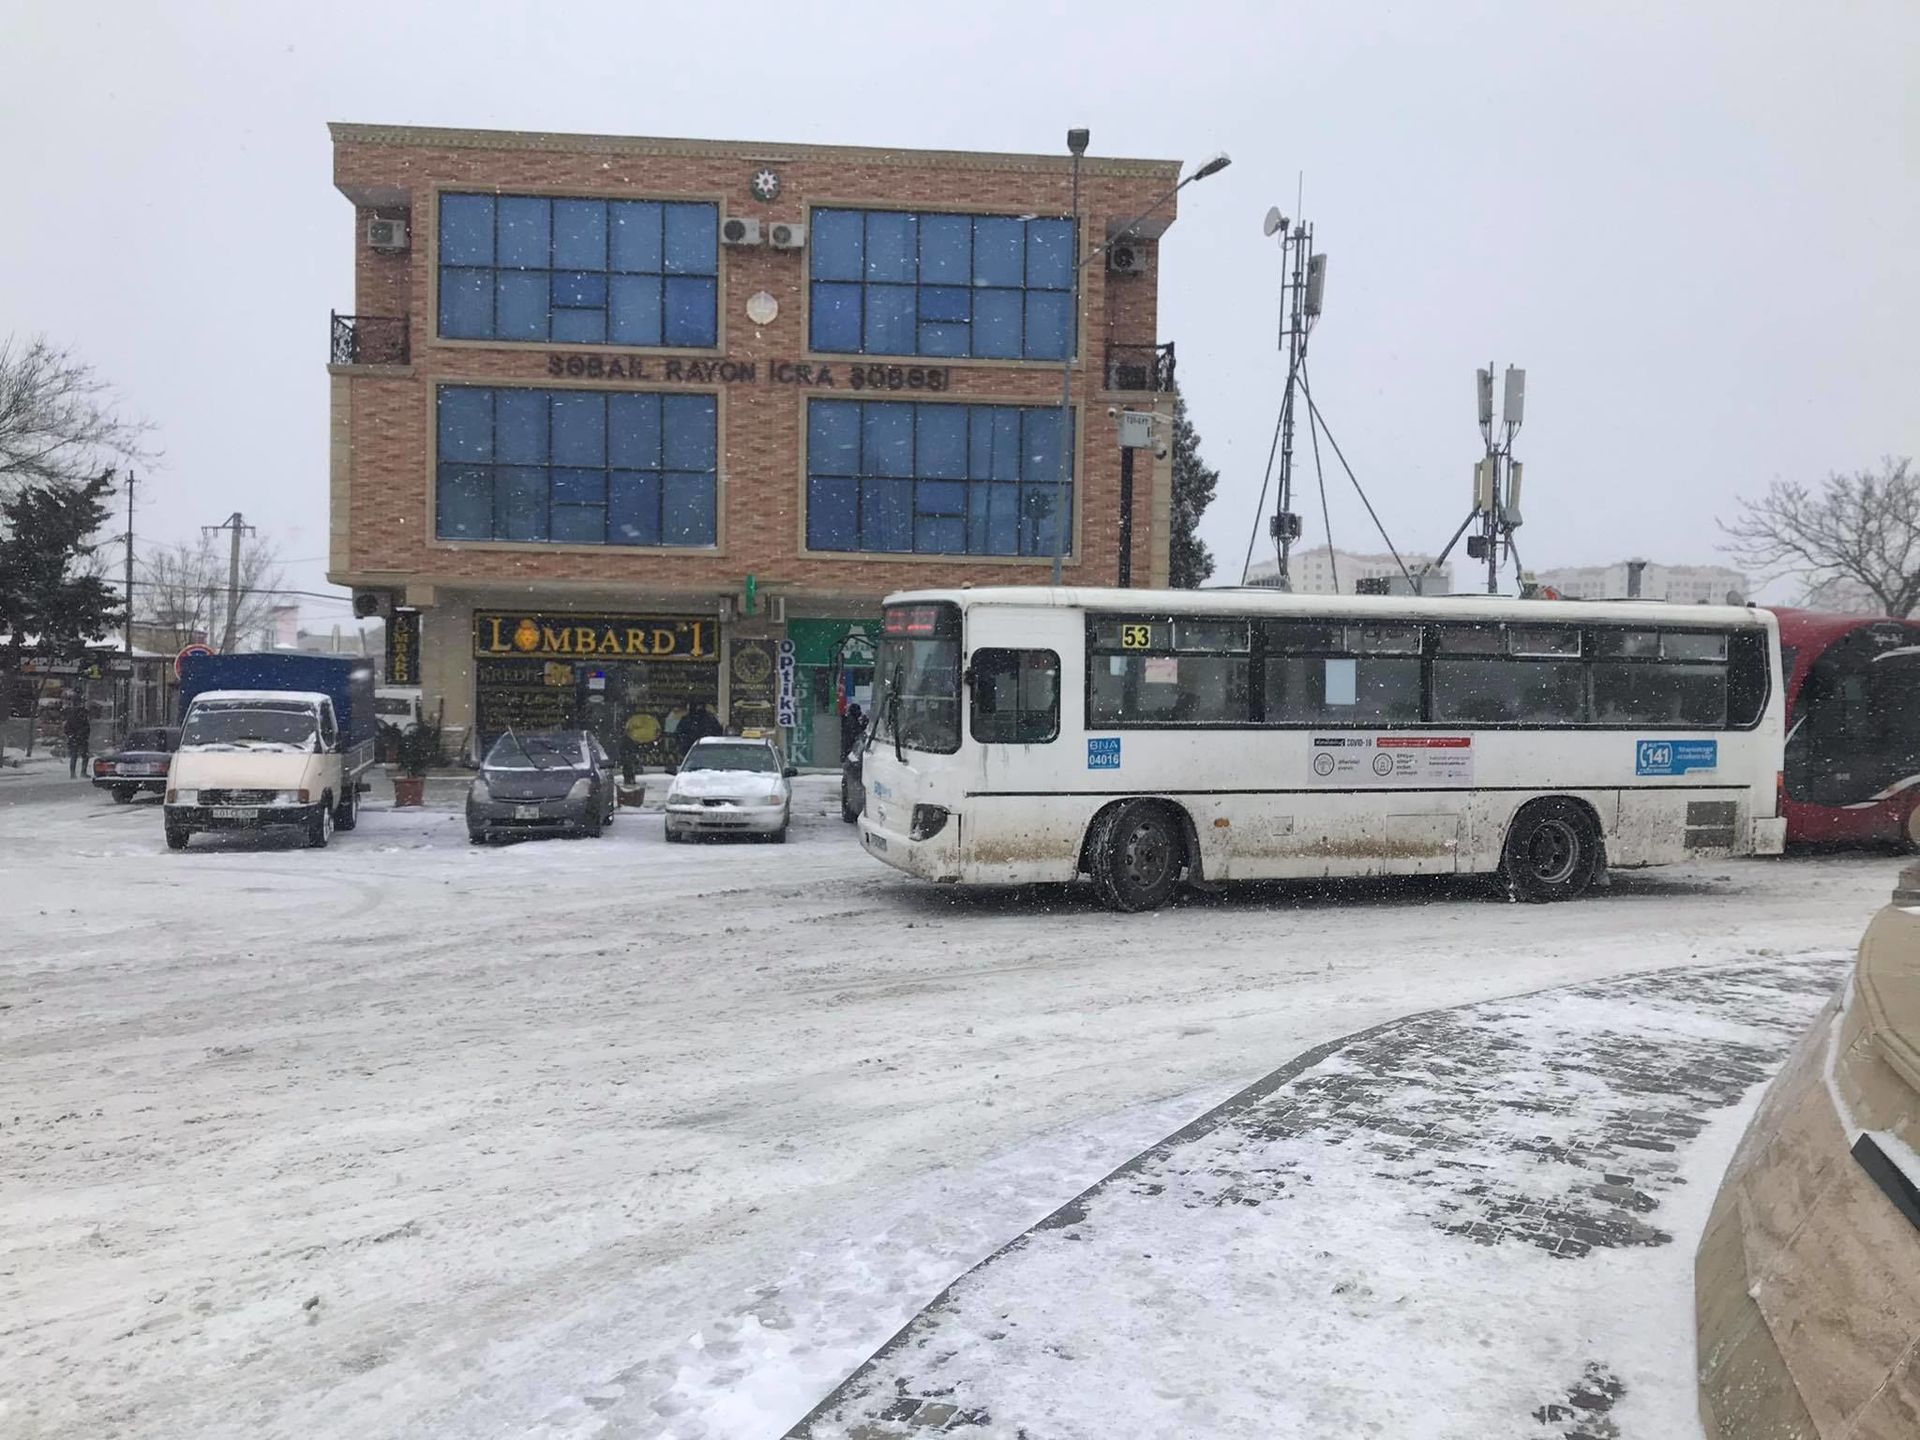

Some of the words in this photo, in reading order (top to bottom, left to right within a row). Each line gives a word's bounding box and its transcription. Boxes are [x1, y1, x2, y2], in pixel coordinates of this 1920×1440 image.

[666, 360, 756, 383] RAYON
[1124, 626, 1150, 647] 53
[790, 668, 809, 763] APTEK
[1089, 740, 1118, 750] BNA
[1088, 753, 1119, 765] 04016
[1646, 747, 1669, 764] 141
